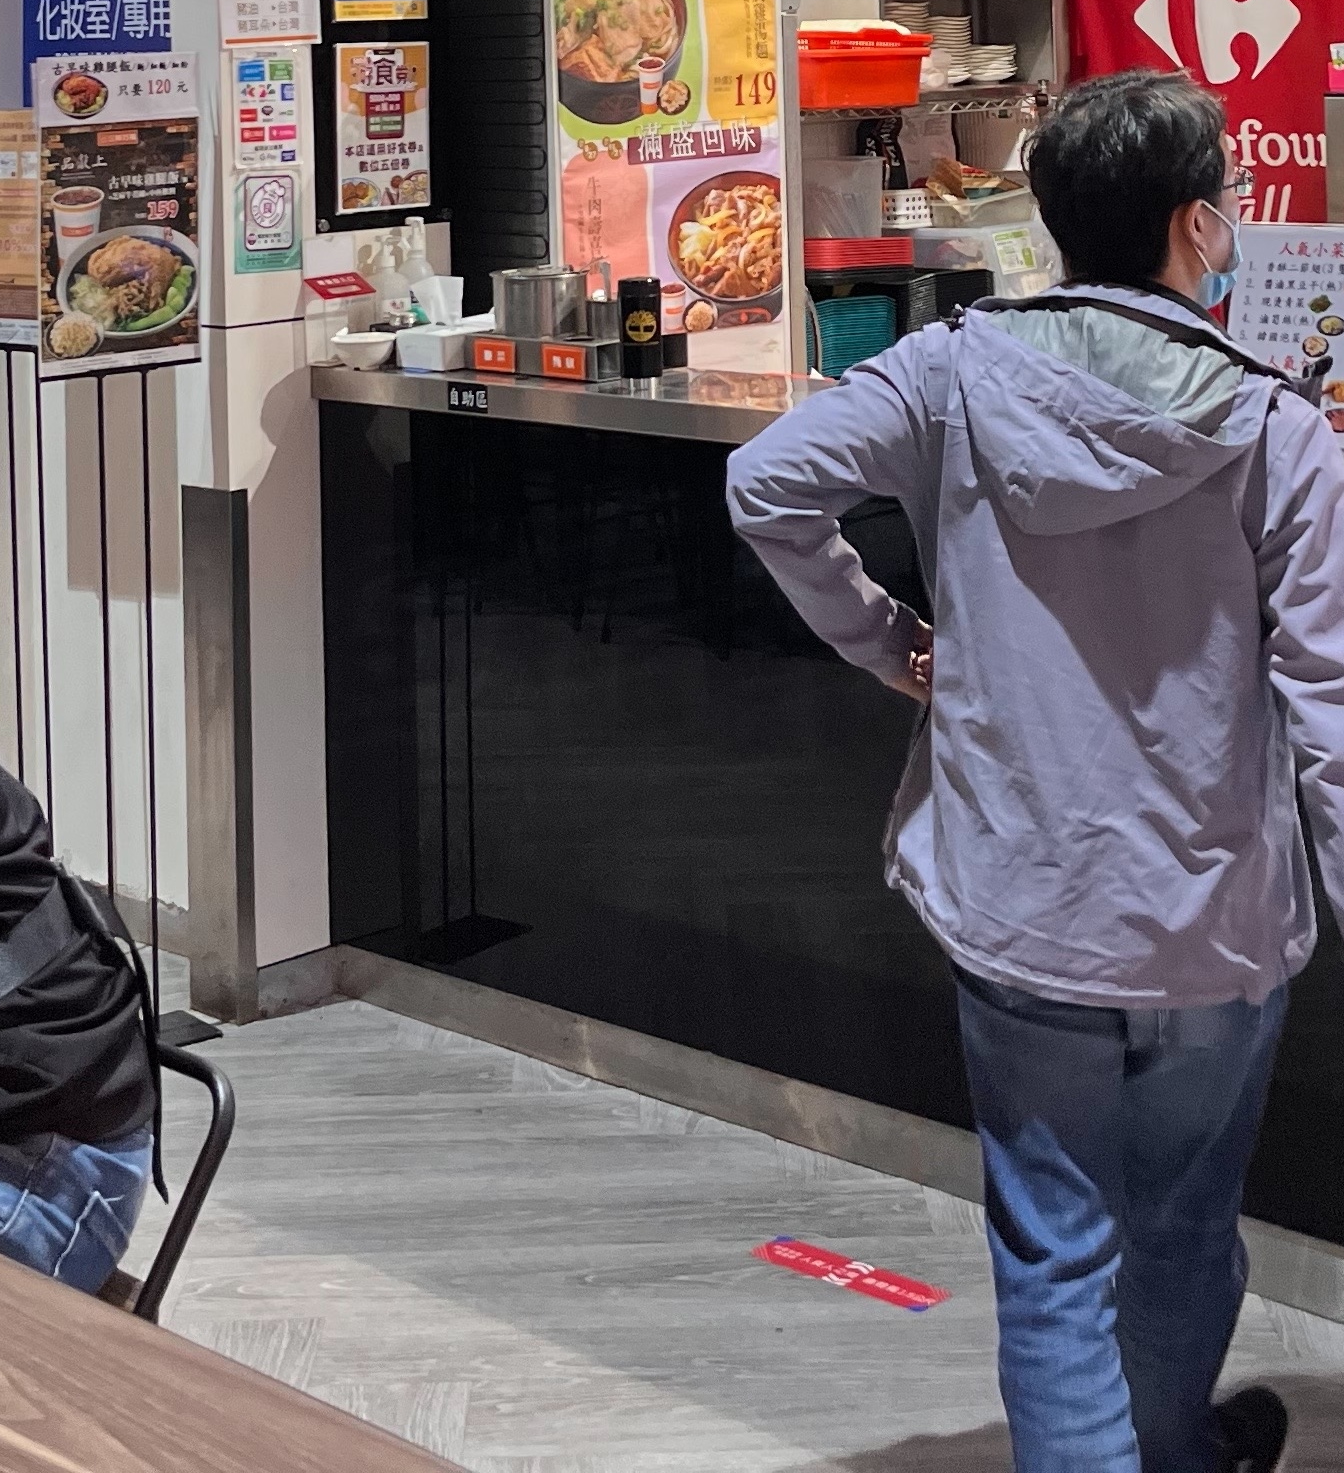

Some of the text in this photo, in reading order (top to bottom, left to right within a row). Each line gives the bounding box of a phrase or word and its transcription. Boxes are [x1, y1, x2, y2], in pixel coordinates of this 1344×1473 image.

[147, 79, 171, 95] 120
[735, 71, 777, 106] 149
[637, 116, 757, 162] 滿盛回味
[147, 199, 179, 220] 159
[1278, 242, 1344, 258] 人氣小菜
[450, 387, 488, 408] 自助區
